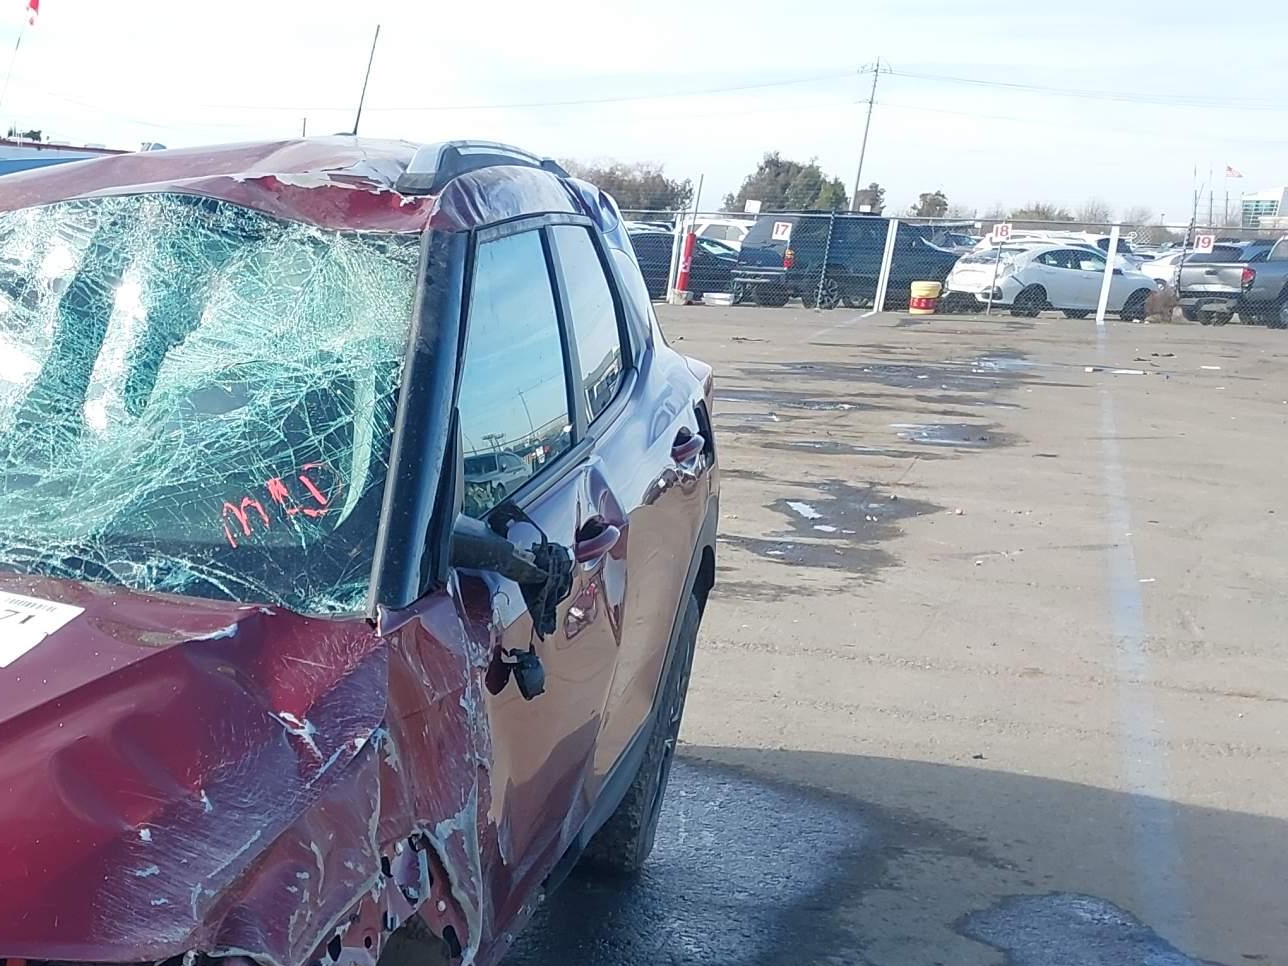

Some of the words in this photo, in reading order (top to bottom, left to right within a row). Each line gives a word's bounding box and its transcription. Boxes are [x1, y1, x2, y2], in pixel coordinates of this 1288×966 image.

[774, 223, 789, 236] 17
[995, 225, 1009, 238] 18
[1195, 236, 1212, 249] 19
